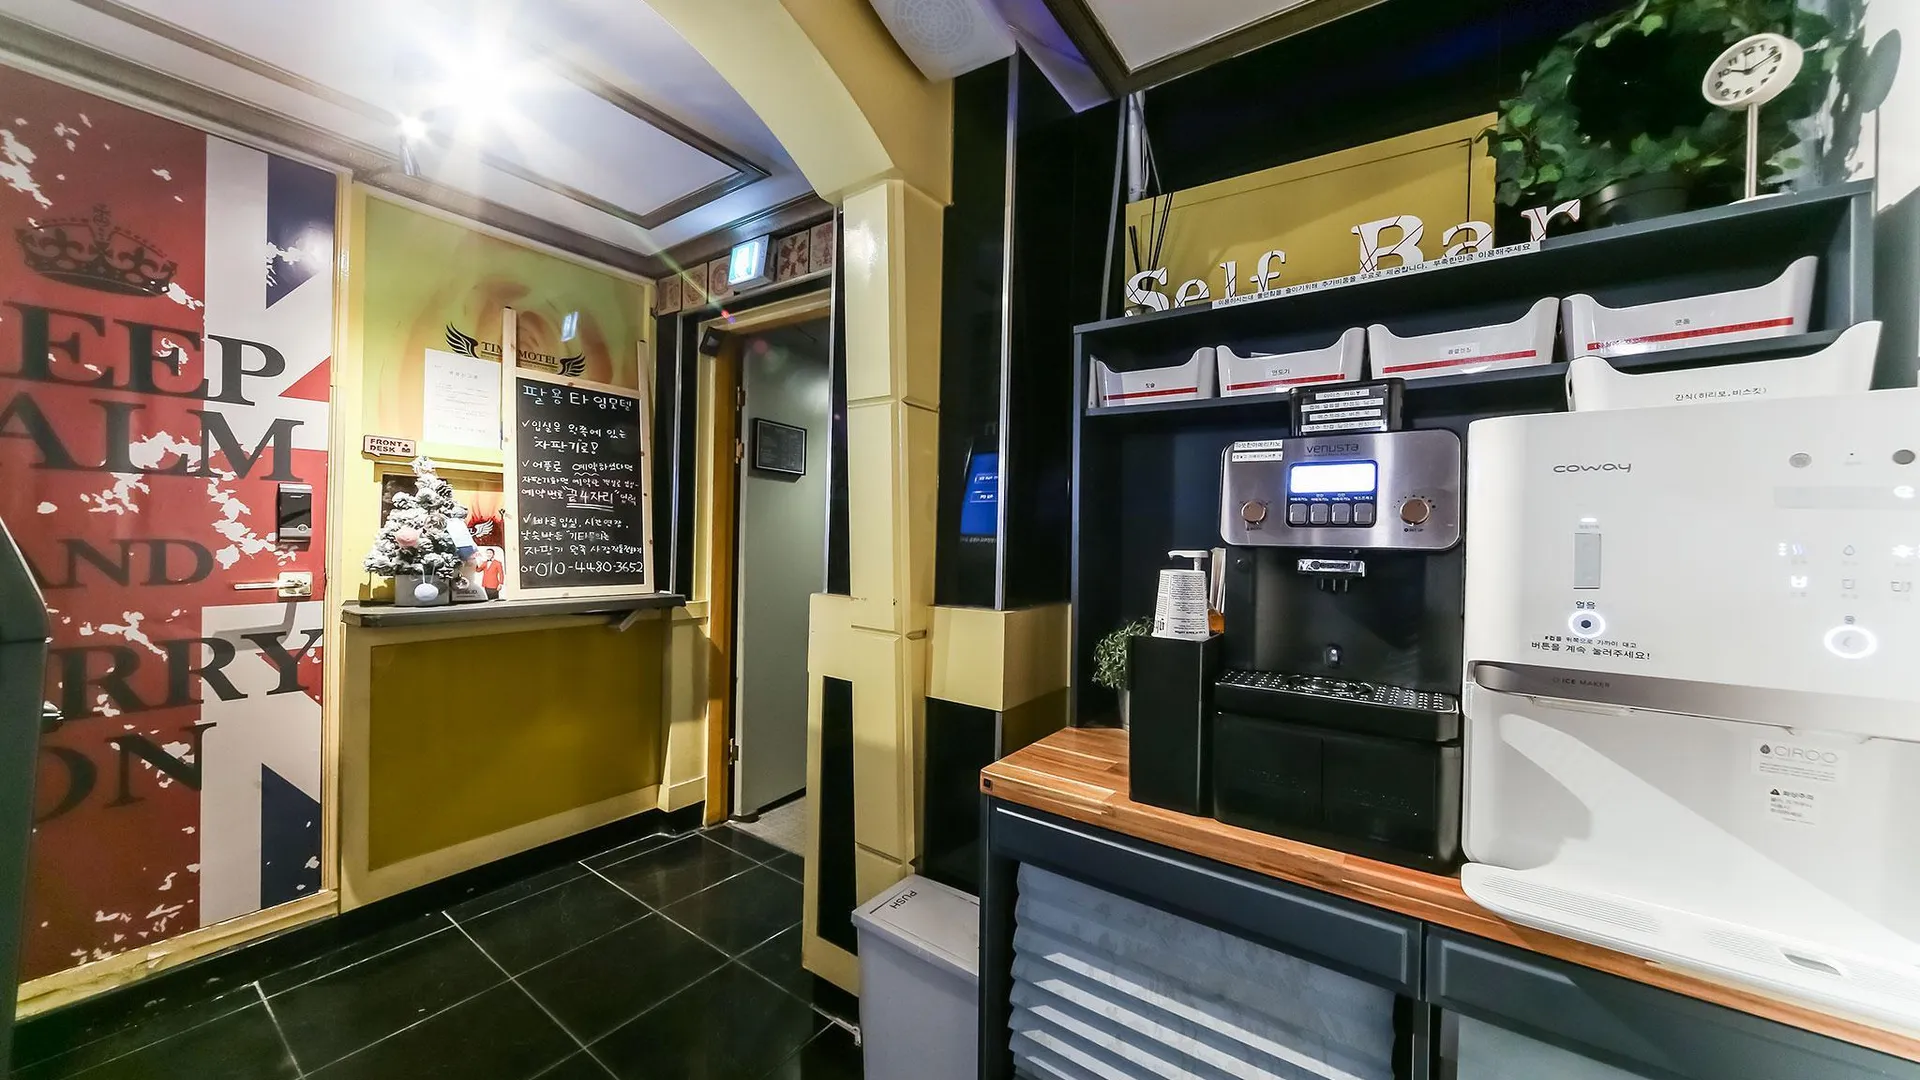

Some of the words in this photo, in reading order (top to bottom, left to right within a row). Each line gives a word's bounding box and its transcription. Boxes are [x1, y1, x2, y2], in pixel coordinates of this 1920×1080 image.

[1124, 250, 1285, 317] Self
[1351, 199, 1580, 274] Bar
[1386, 263, 1428, 275] 제공합니다.
[1478, 243, 1531, 259] 이용해주세요
[518, 349, 559, 365] MOTEL
[531, 420, 561, 434] 입실은
[606, 429, 626, 439] 있는
[370, 438, 402, 447] FRONT
[370, 445, 395, 453] DESK
[532, 460, 562, 473] 어플로
[1553, 463, 1632, 473] coway
[523, 545, 564, 556] 자판기
[535, 560, 644, 577] 010-4480-3652
[1575, 600, 1596, 610] 얼음
[1531, 641, 1560, 652] 버튼을
[1566, 644, 1587, 654] 계속
[1592, 647, 1651, 660] 눌러주세요!
[1597, 639, 1618, 647] 가까이
[1622, 641, 1637, 649] 대고
[1580, 680, 1611, 688] MAKER
[889, 889, 918, 910] PUSH
